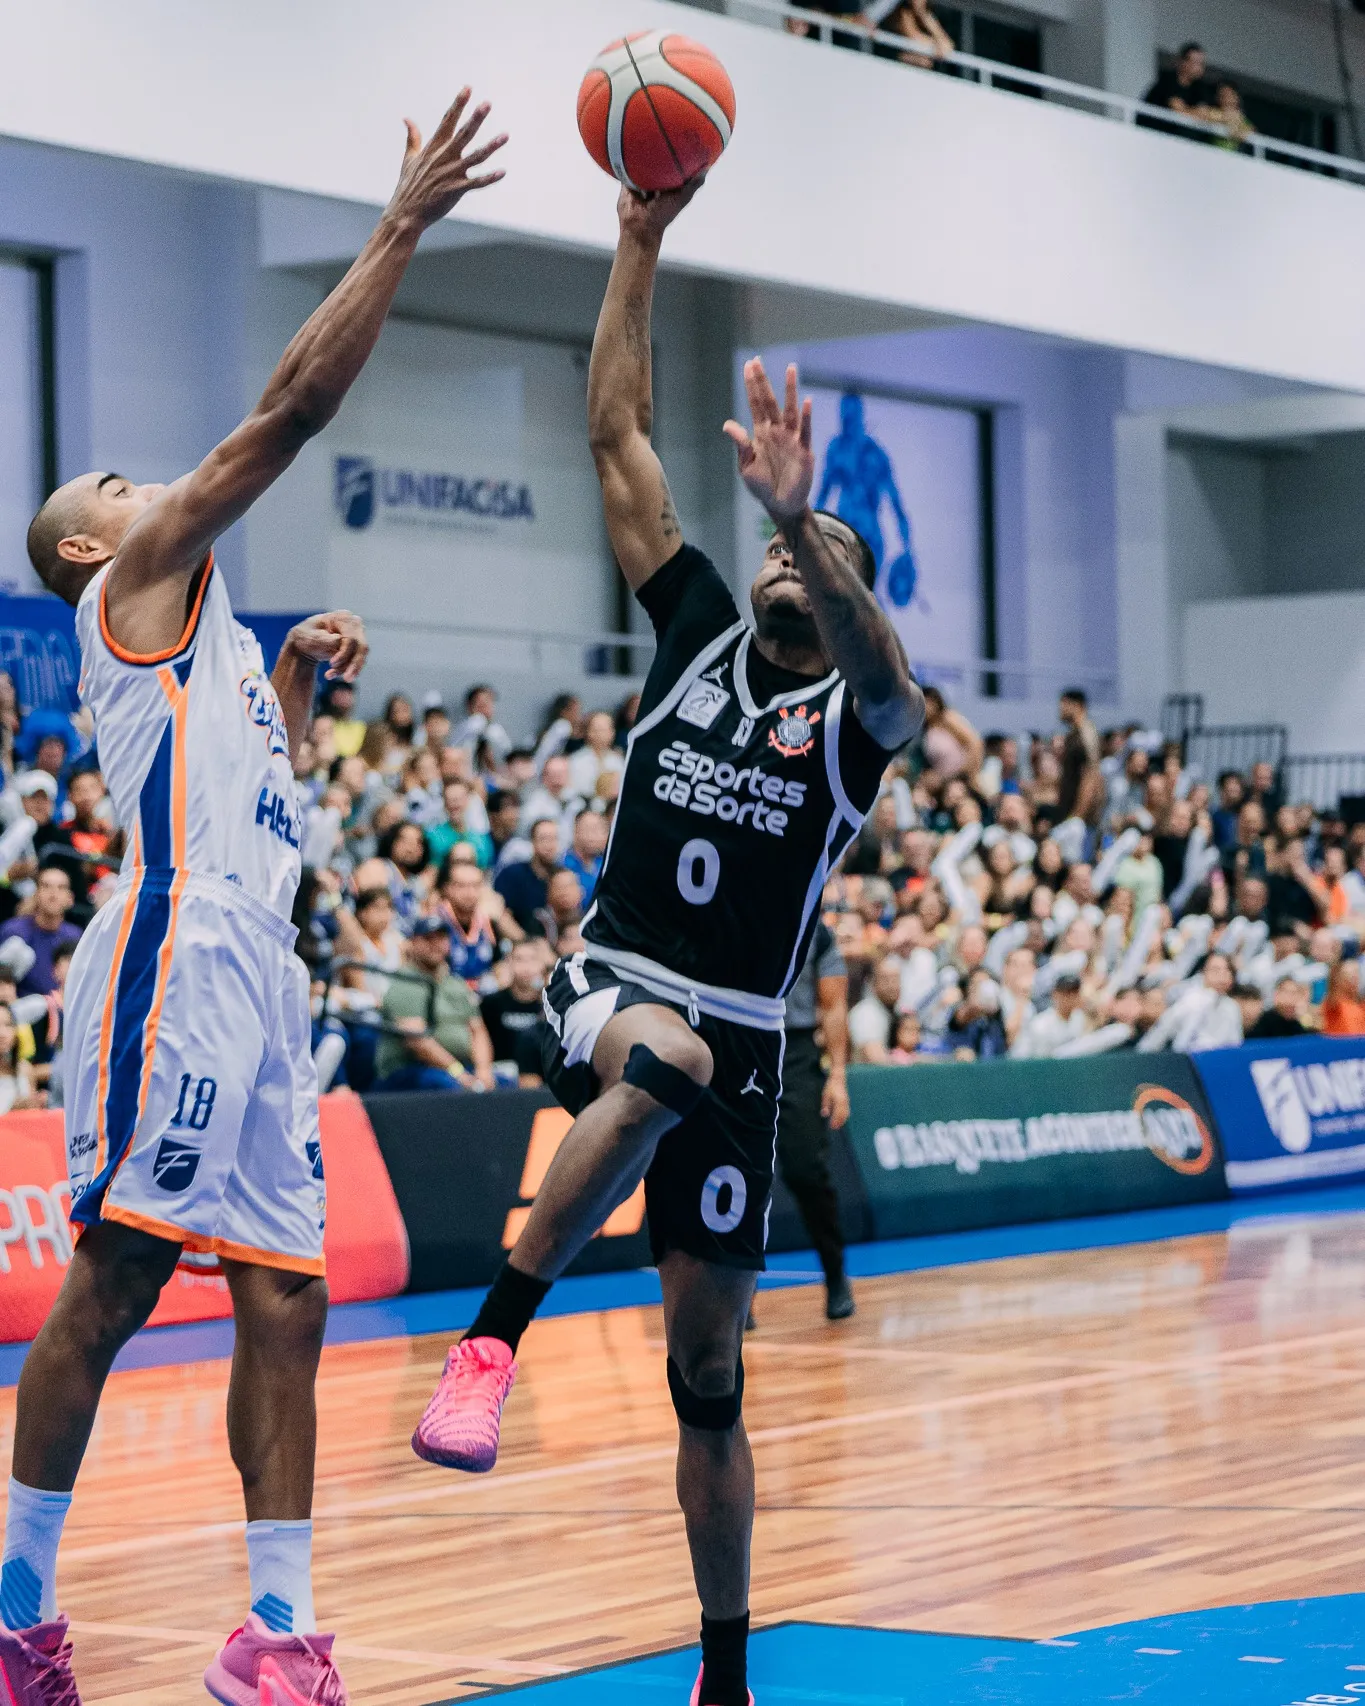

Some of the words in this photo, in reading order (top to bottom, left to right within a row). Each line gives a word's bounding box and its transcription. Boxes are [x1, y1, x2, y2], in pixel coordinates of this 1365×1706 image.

[658, 740, 808, 808] Esportes
[676, 837, 721, 906] 0
[169, 1072, 218, 1132] 18
[700, 1164, 748, 1234] 0
